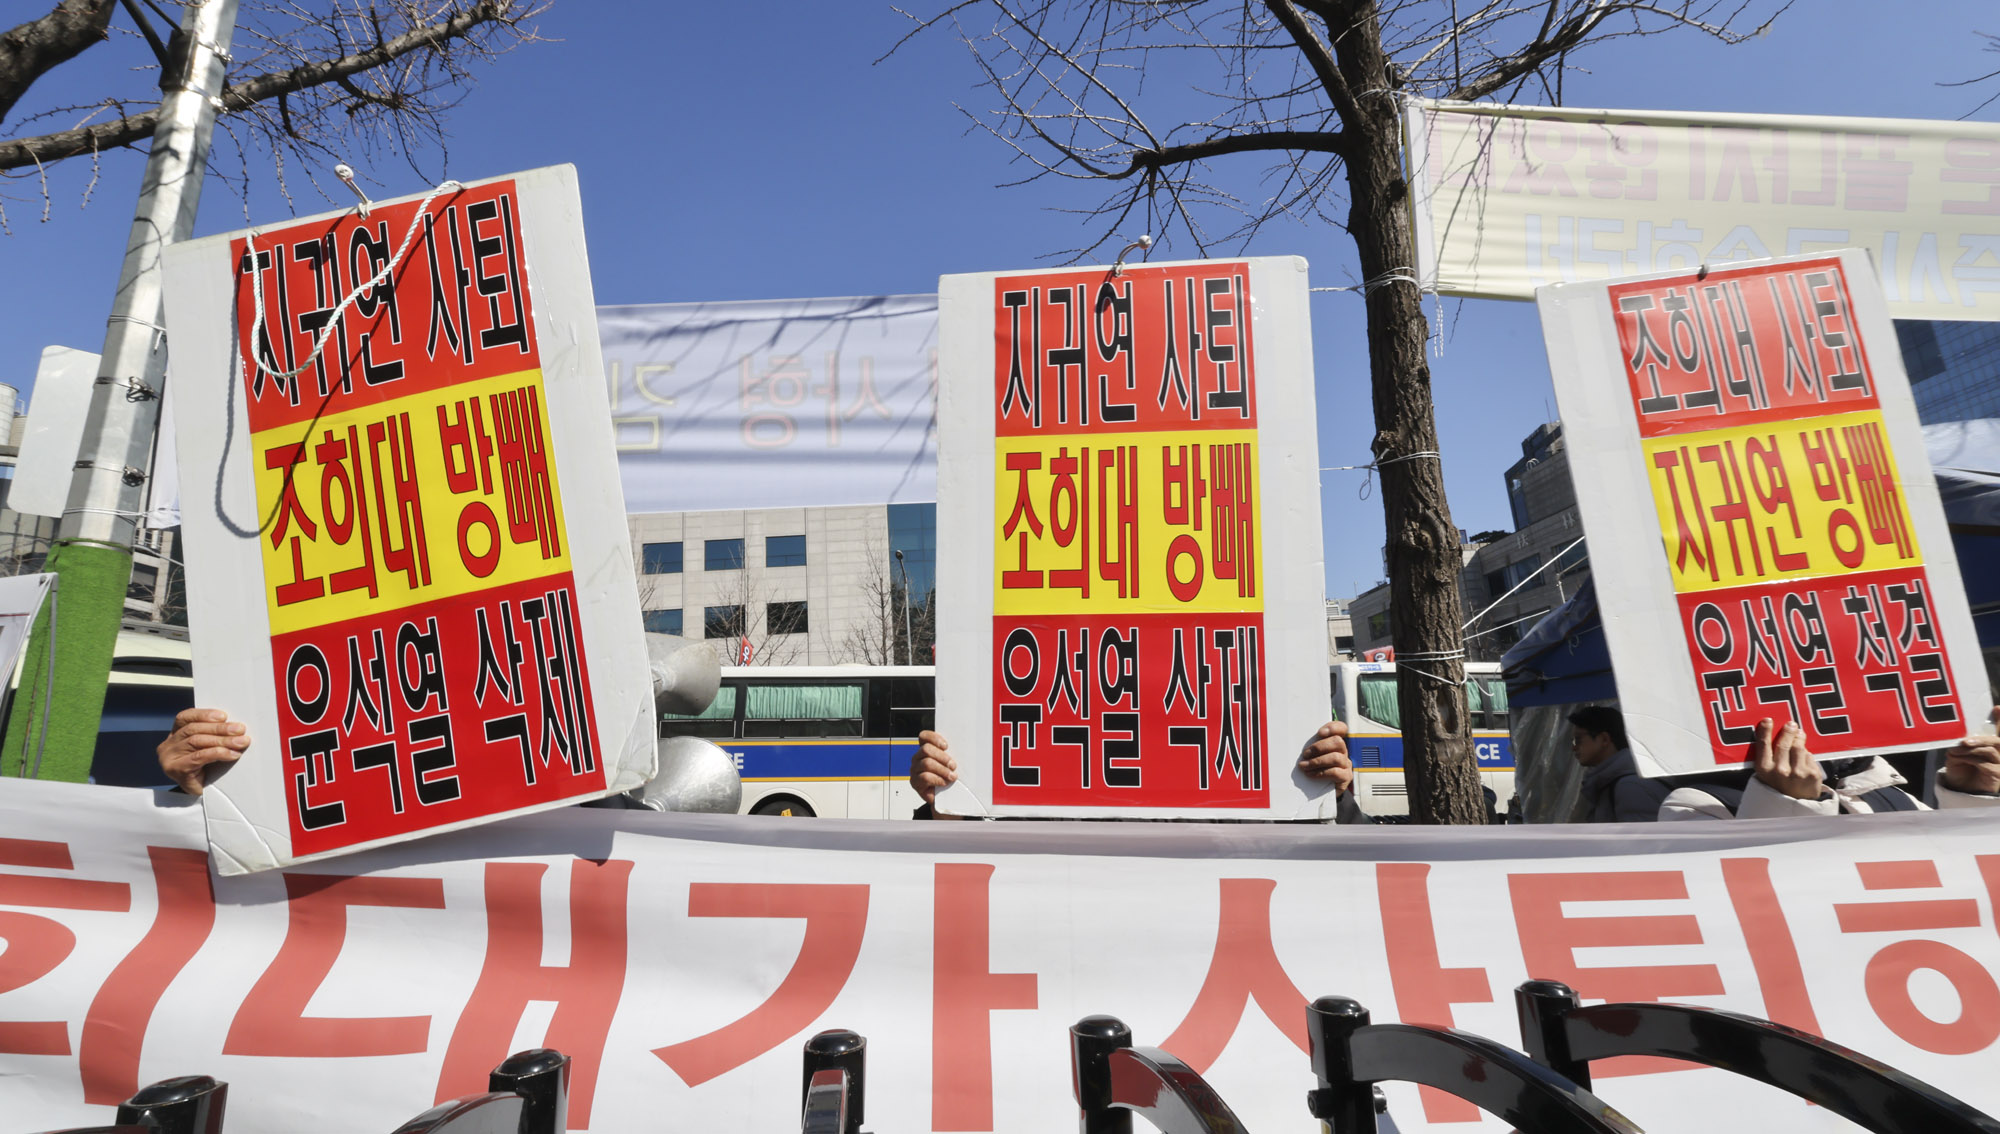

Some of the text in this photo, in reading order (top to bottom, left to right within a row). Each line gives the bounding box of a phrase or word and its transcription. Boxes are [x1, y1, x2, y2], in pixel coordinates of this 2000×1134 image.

[242, 194, 530, 406] 지귀연 사퇴
[1000, 281, 1137, 430] 지귀연
[1158, 273, 1250, 422] 사퇴
[1618, 268, 1872, 415] 조희대 사퇴
[264, 384, 562, 608] 조희대 방빼
[1001, 441, 1257, 603] 조희대 방빼
[1653, 421, 1916, 583] 지귀연 방빼
[285, 588, 596, 832] 윤석열 삭제
[1000, 625, 1262, 792] 윤석열 삭제
[1691, 578, 1961, 747] 윤석열 척결
